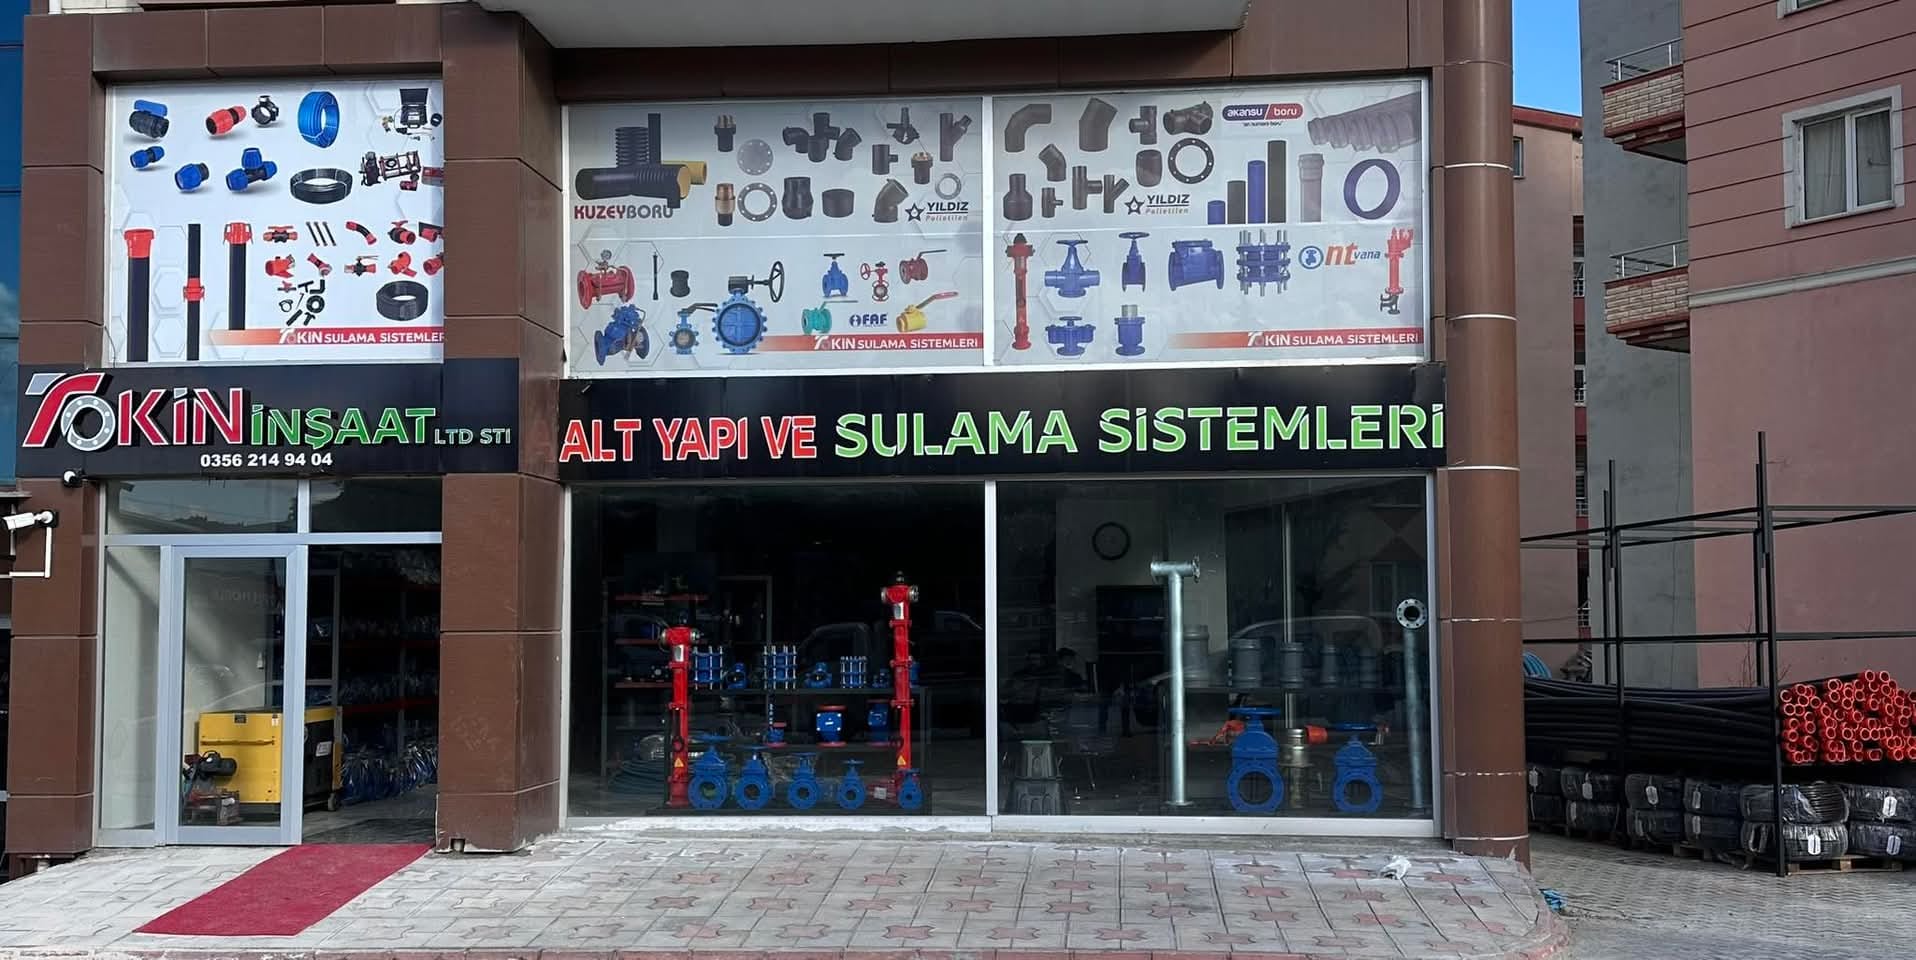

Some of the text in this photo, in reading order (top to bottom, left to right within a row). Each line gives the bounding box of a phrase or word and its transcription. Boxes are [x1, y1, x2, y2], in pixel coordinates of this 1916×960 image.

[1227, 107, 1297, 117] akansu boru
[1147, 194, 1190, 204] YILDIZ
[927, 201, 969, 211] YILDIZ
[574, 205, 673, 219] KUZEYBORU
[1325, 243, 1381, 265] nt vana
[863, 314, 888, 325] FAF
[324, 333, 376, 344] SULAMA
[857, 339, 907, 349] SULAMA
[1292, 335, 1344, 346] SULAMA
[250, 404, 437, 450] İNŞAAT
[434, 428, 474, 445] LTD
[558, 403, 1444, 463] ALT YAPI VE SULAMA SİSTEMLERİ
[200, 452, 333, 467] 0356 214 94 04
